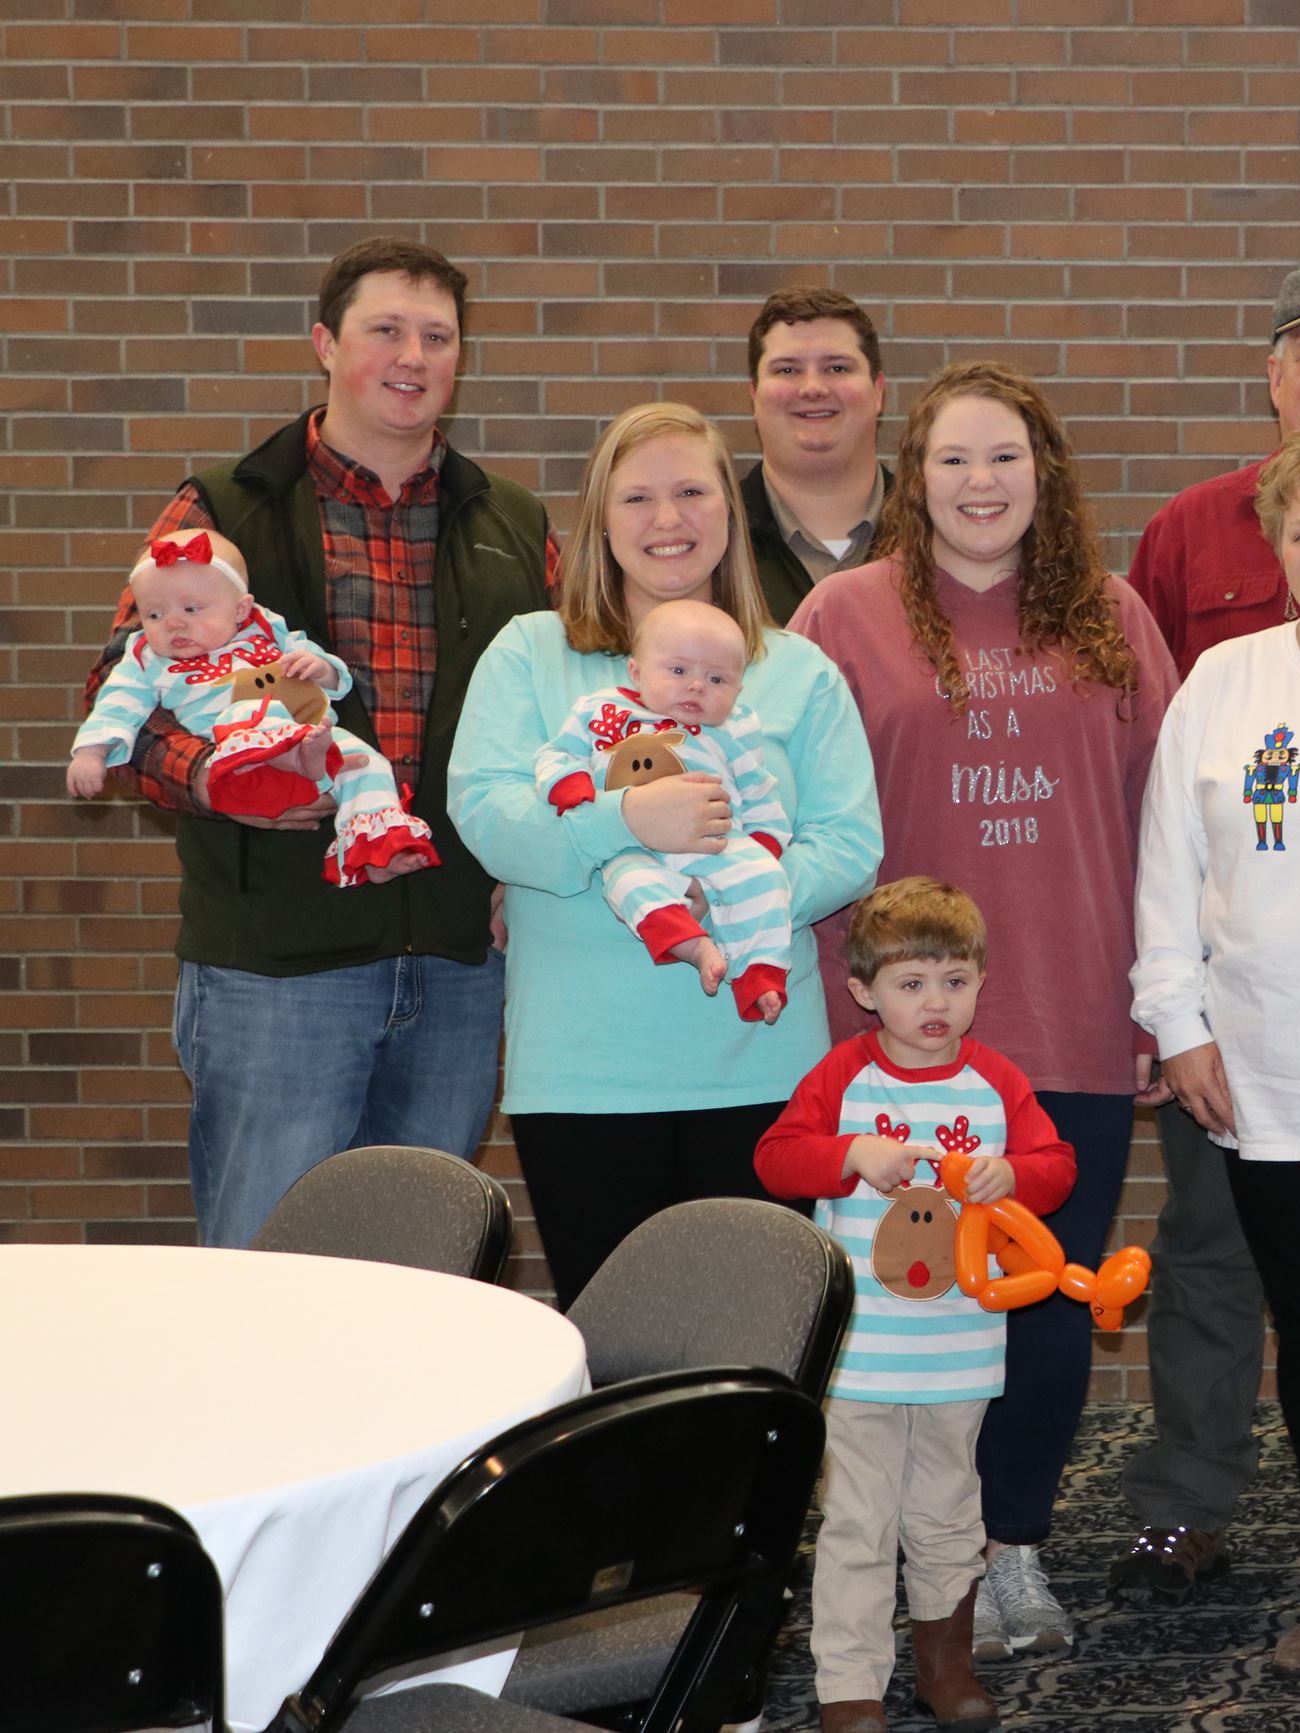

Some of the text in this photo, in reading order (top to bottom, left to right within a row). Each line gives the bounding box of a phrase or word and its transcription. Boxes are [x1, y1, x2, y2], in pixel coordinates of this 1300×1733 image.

[964, 648, 1013, 672] LAST
[935, 666, 1057, 699] CRISTMAS
[967, 707, 1021, 739] AS A
[979, 816, 1039, 847] 2018
